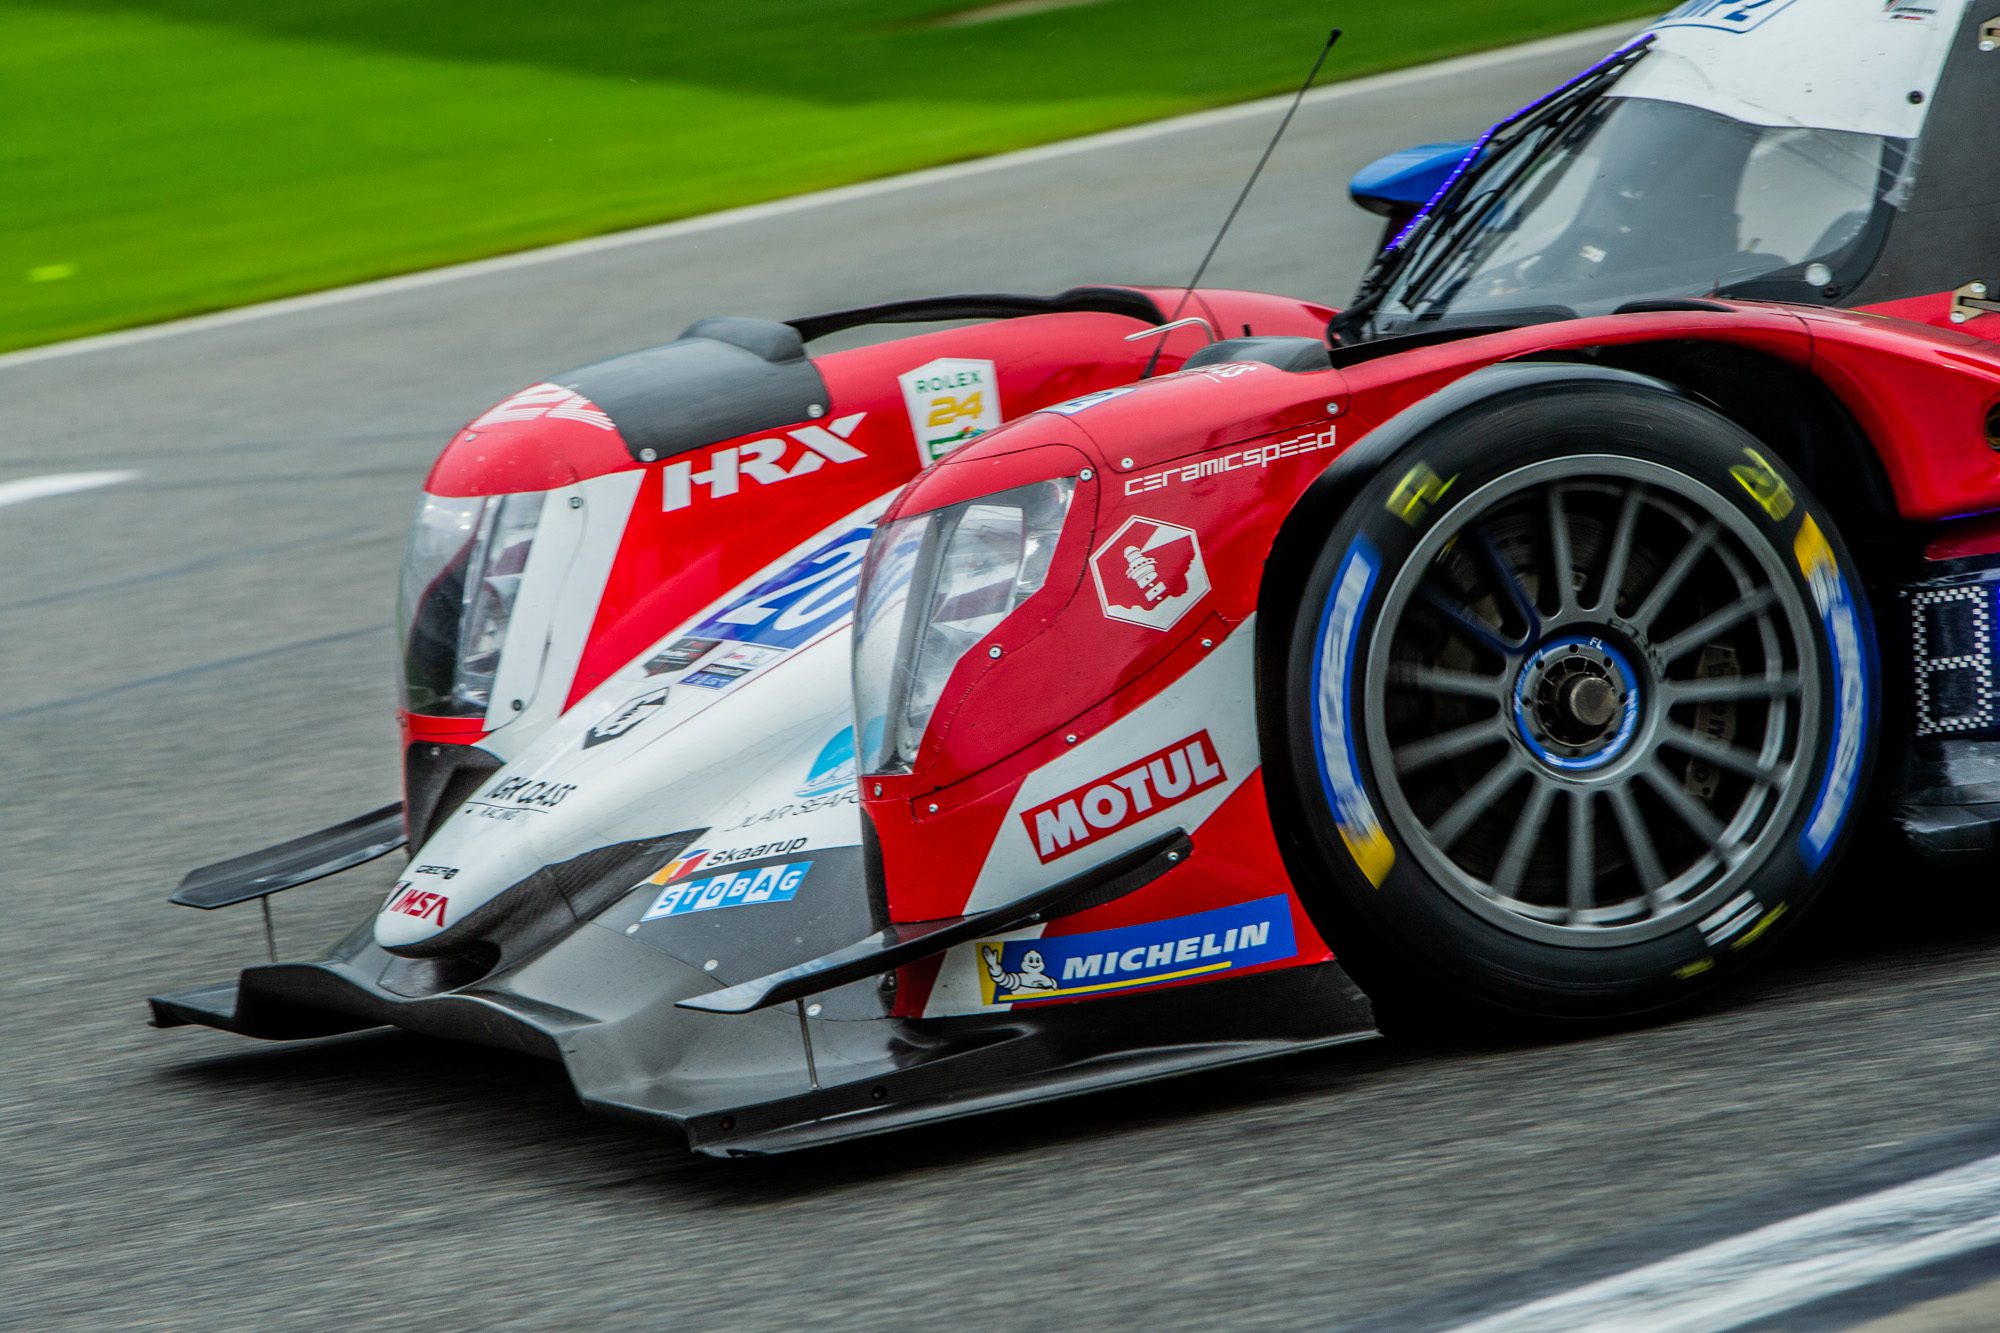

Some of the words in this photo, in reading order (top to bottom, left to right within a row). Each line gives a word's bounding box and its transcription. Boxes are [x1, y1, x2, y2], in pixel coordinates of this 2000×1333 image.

[914, 370, 982, 394] ROLEX
[927, 391, 985, 427] 24
[662, 412, 868, 512] HRX
[1589, 636, 1603, 650] FL
[1038, 746, 1221, 857] MOTUL
[706, 836, 808, 867] Skaarup
[657, 870, 803, 909] STOBAG
[1062, 922, 1270, 980] MICHELIN
